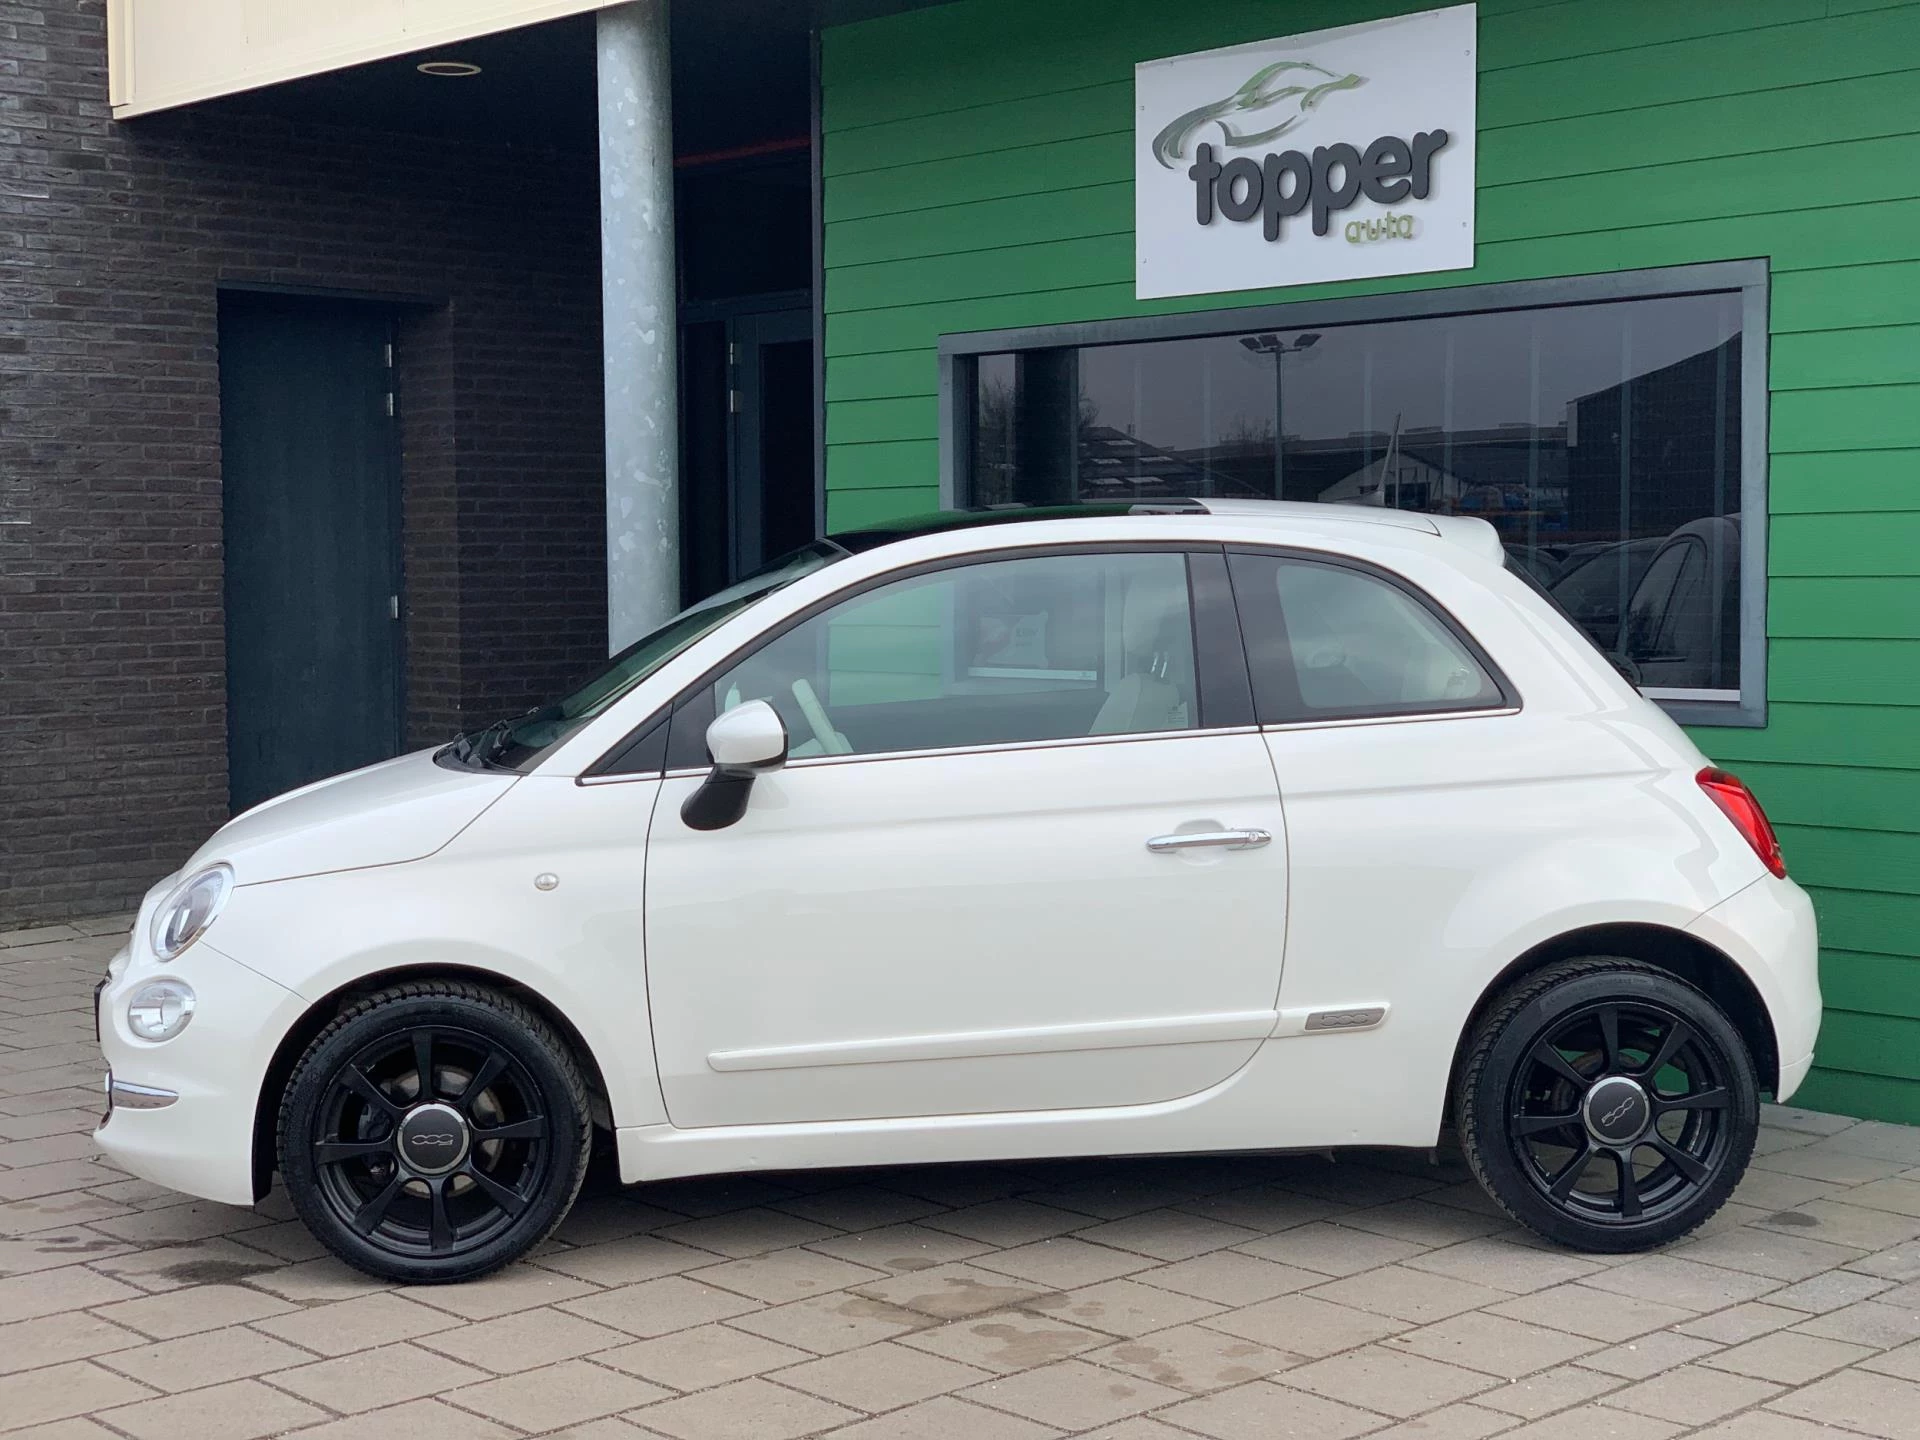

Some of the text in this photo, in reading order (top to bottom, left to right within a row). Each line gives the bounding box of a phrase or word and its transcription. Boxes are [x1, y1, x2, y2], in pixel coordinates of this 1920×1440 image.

[1188, 129, 1449, 242] topper
[1344, 211, 1414, 243] auto
[1320, 1012, 1369, 1027] 500
[1601, 1096, 1635, 1127] 500
[411, 1133, 454, 1147] 500
